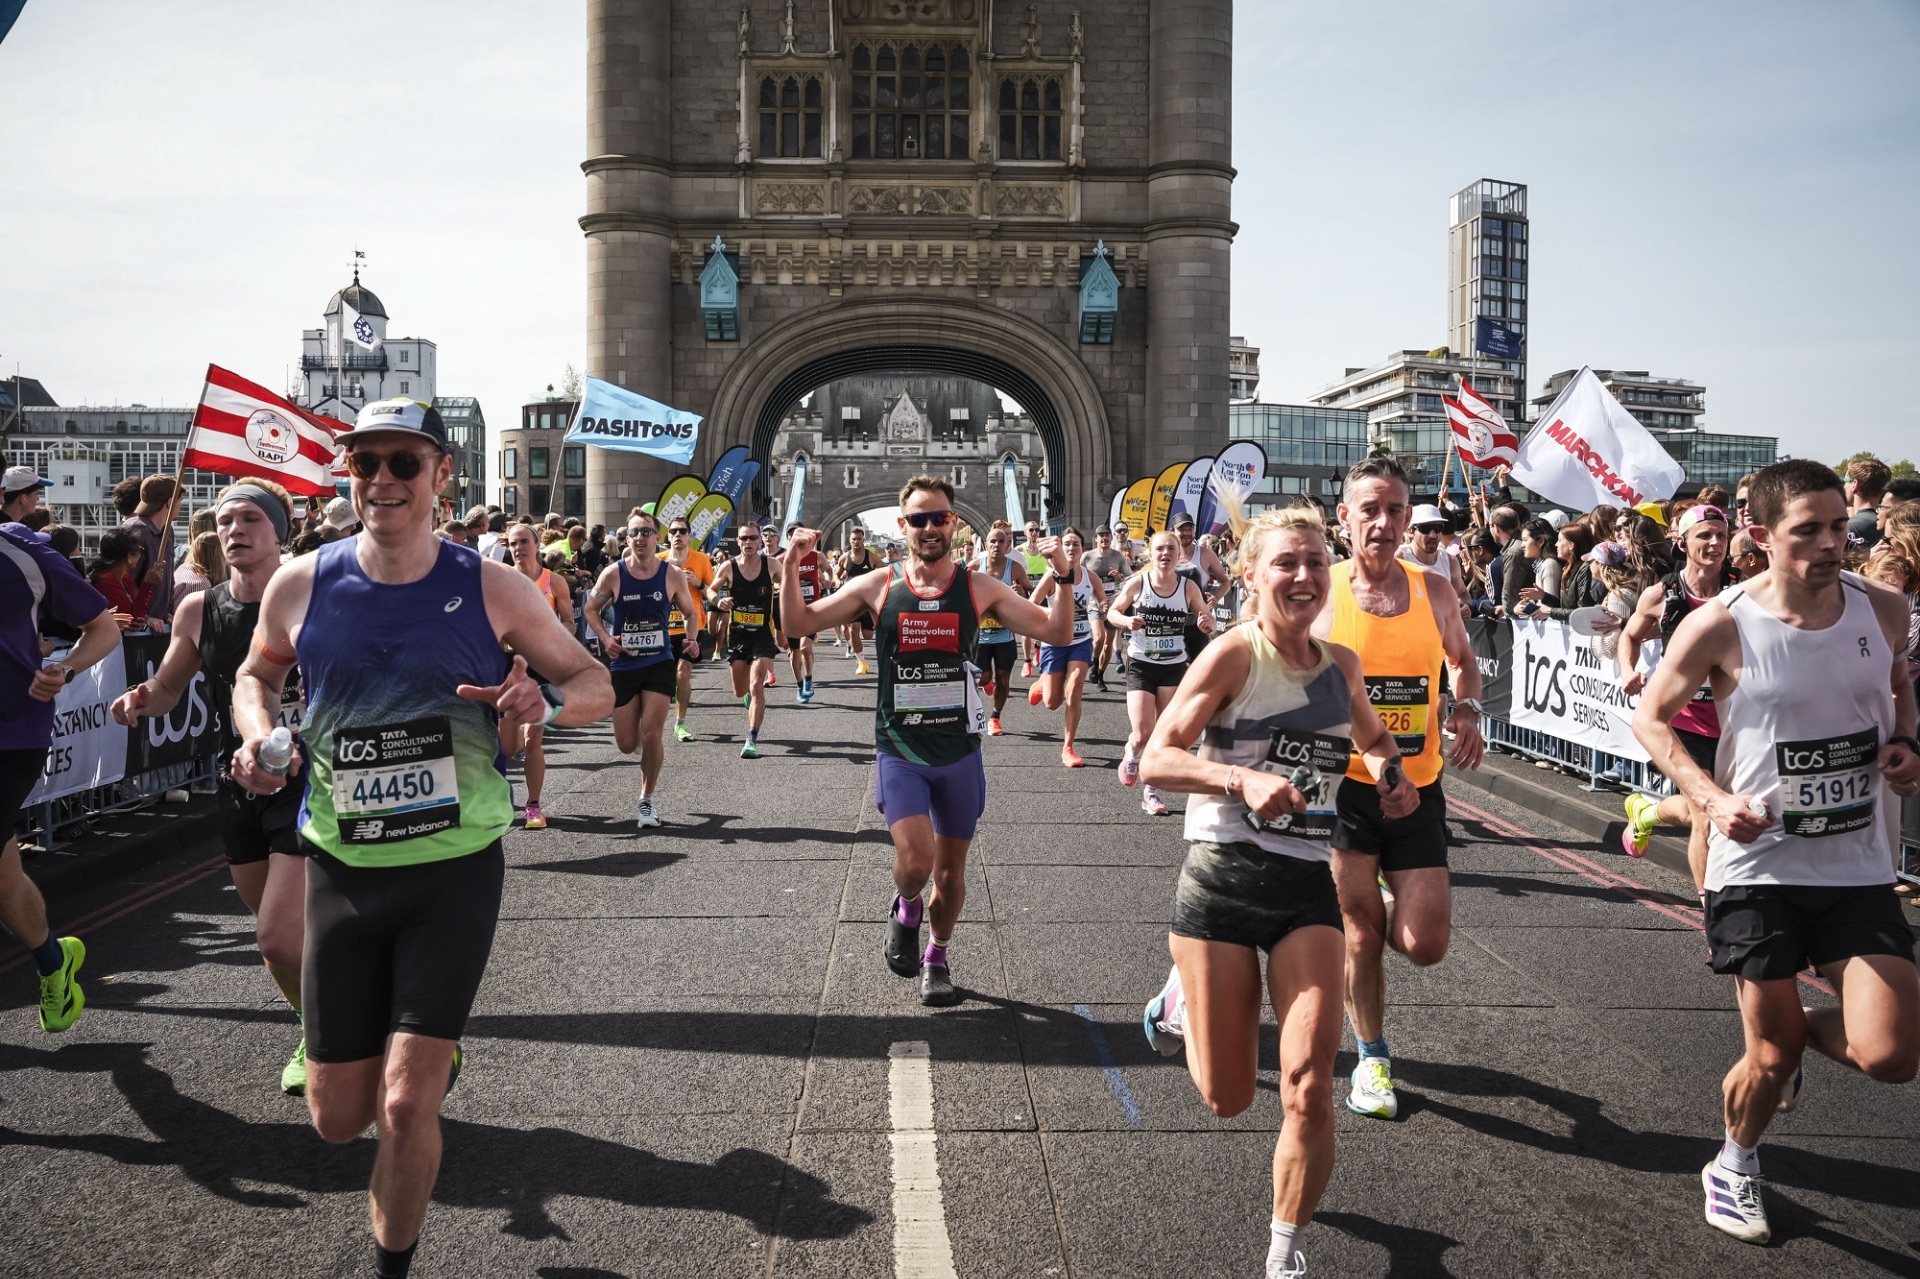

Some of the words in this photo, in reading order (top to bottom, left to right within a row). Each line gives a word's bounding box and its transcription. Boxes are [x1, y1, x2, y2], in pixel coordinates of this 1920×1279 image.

[581, 417, 692, 439] DASHTONS
[1222, 460, 1245, 471] North
[739, 614, 757, 624] 3956
[902, 618, 929, 627] Army
[623, 621, 639, 632] tcs
[902, 627, 955, 636] Benevolent
[627, 634, 657, 646] 44767
[902, 636, 927, 644] Fund
[1153, 639, 1174, 649] 1003
[897, 664, 923, 680] tcs
[1524, 638, 1568, 718] tcs
[935, 715, 959, 724] balance
[380, 730, 408, 740] TATA
[381, 733, 444, 750] CONSULTANCY
[1315, 739, 1333, 750] TATA
[1828, 741, 1851, 750] TATA
[340, 737, 378, 762] tcs
[382, 746, 423, 760] SERVICES
[1276, 734, 1311, 763] tcs
[1828, 742, 1876, 758] CONSULTANCY
[1783, 747, 1825, 770] tcs
[1829, 754, 1862, 766] SERVICES
[352, 769, 435, 806] 44450
[1799, 773, 1871, 807] 51912
[385, 826, 407, 838] new
[408, 819, 450, 835] balance
[1828, 819, 1846, 831] new
[1847, 815, 1874, 828] balanc
[1289, 825, 1307, 835] new
[1306, 826, 1332, 836] balance
